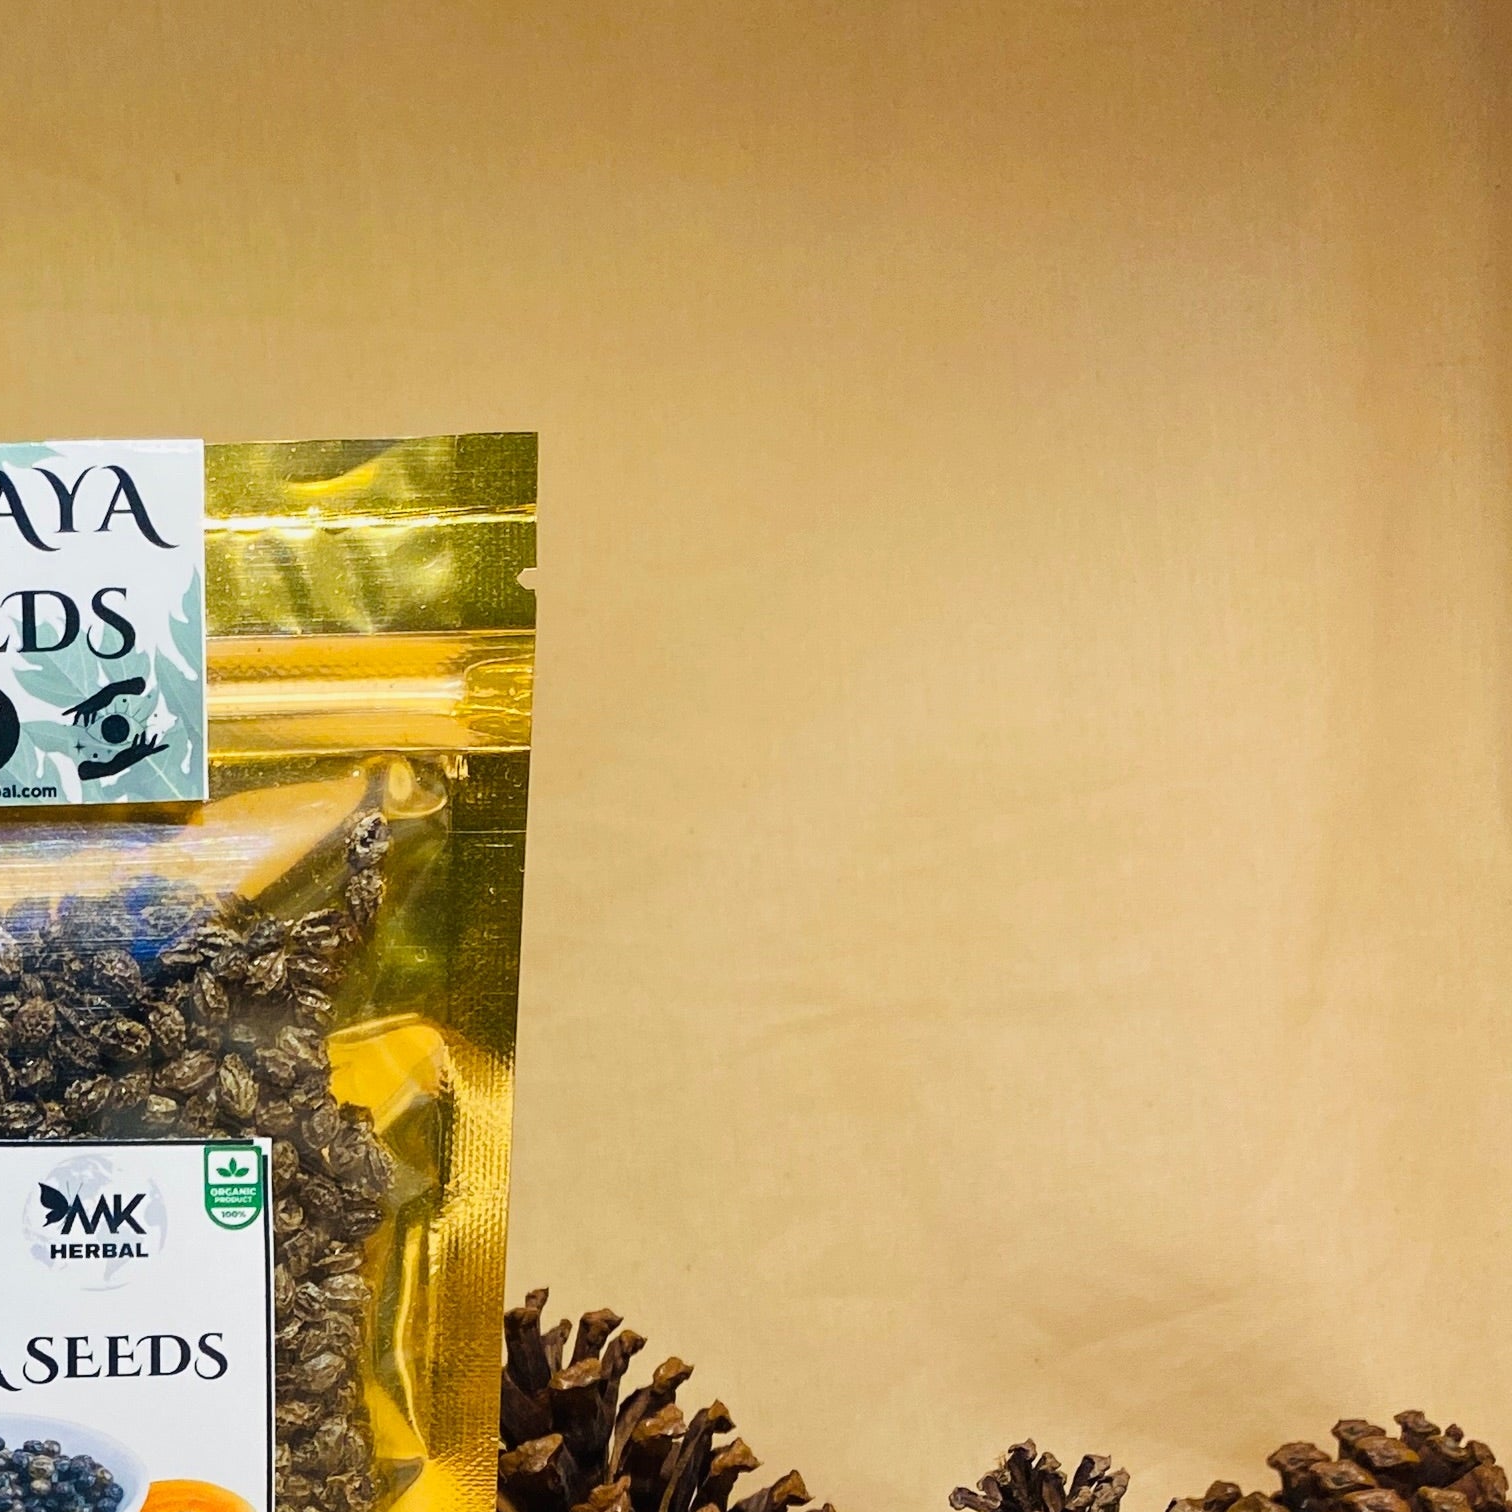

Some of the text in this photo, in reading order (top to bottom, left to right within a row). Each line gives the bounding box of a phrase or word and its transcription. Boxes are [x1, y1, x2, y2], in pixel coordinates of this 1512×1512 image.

[209, 1187, 257, 1197] ORGANIC
[214, 1196, 253, 1204] PRODUCT
[60, 1193, 148, 1236] MK
[221, 1210, 247, 1219] 100%
[50, 1242, 150, 1260] HERBAL
[23, 1331, 230, 1386] SEEDS
